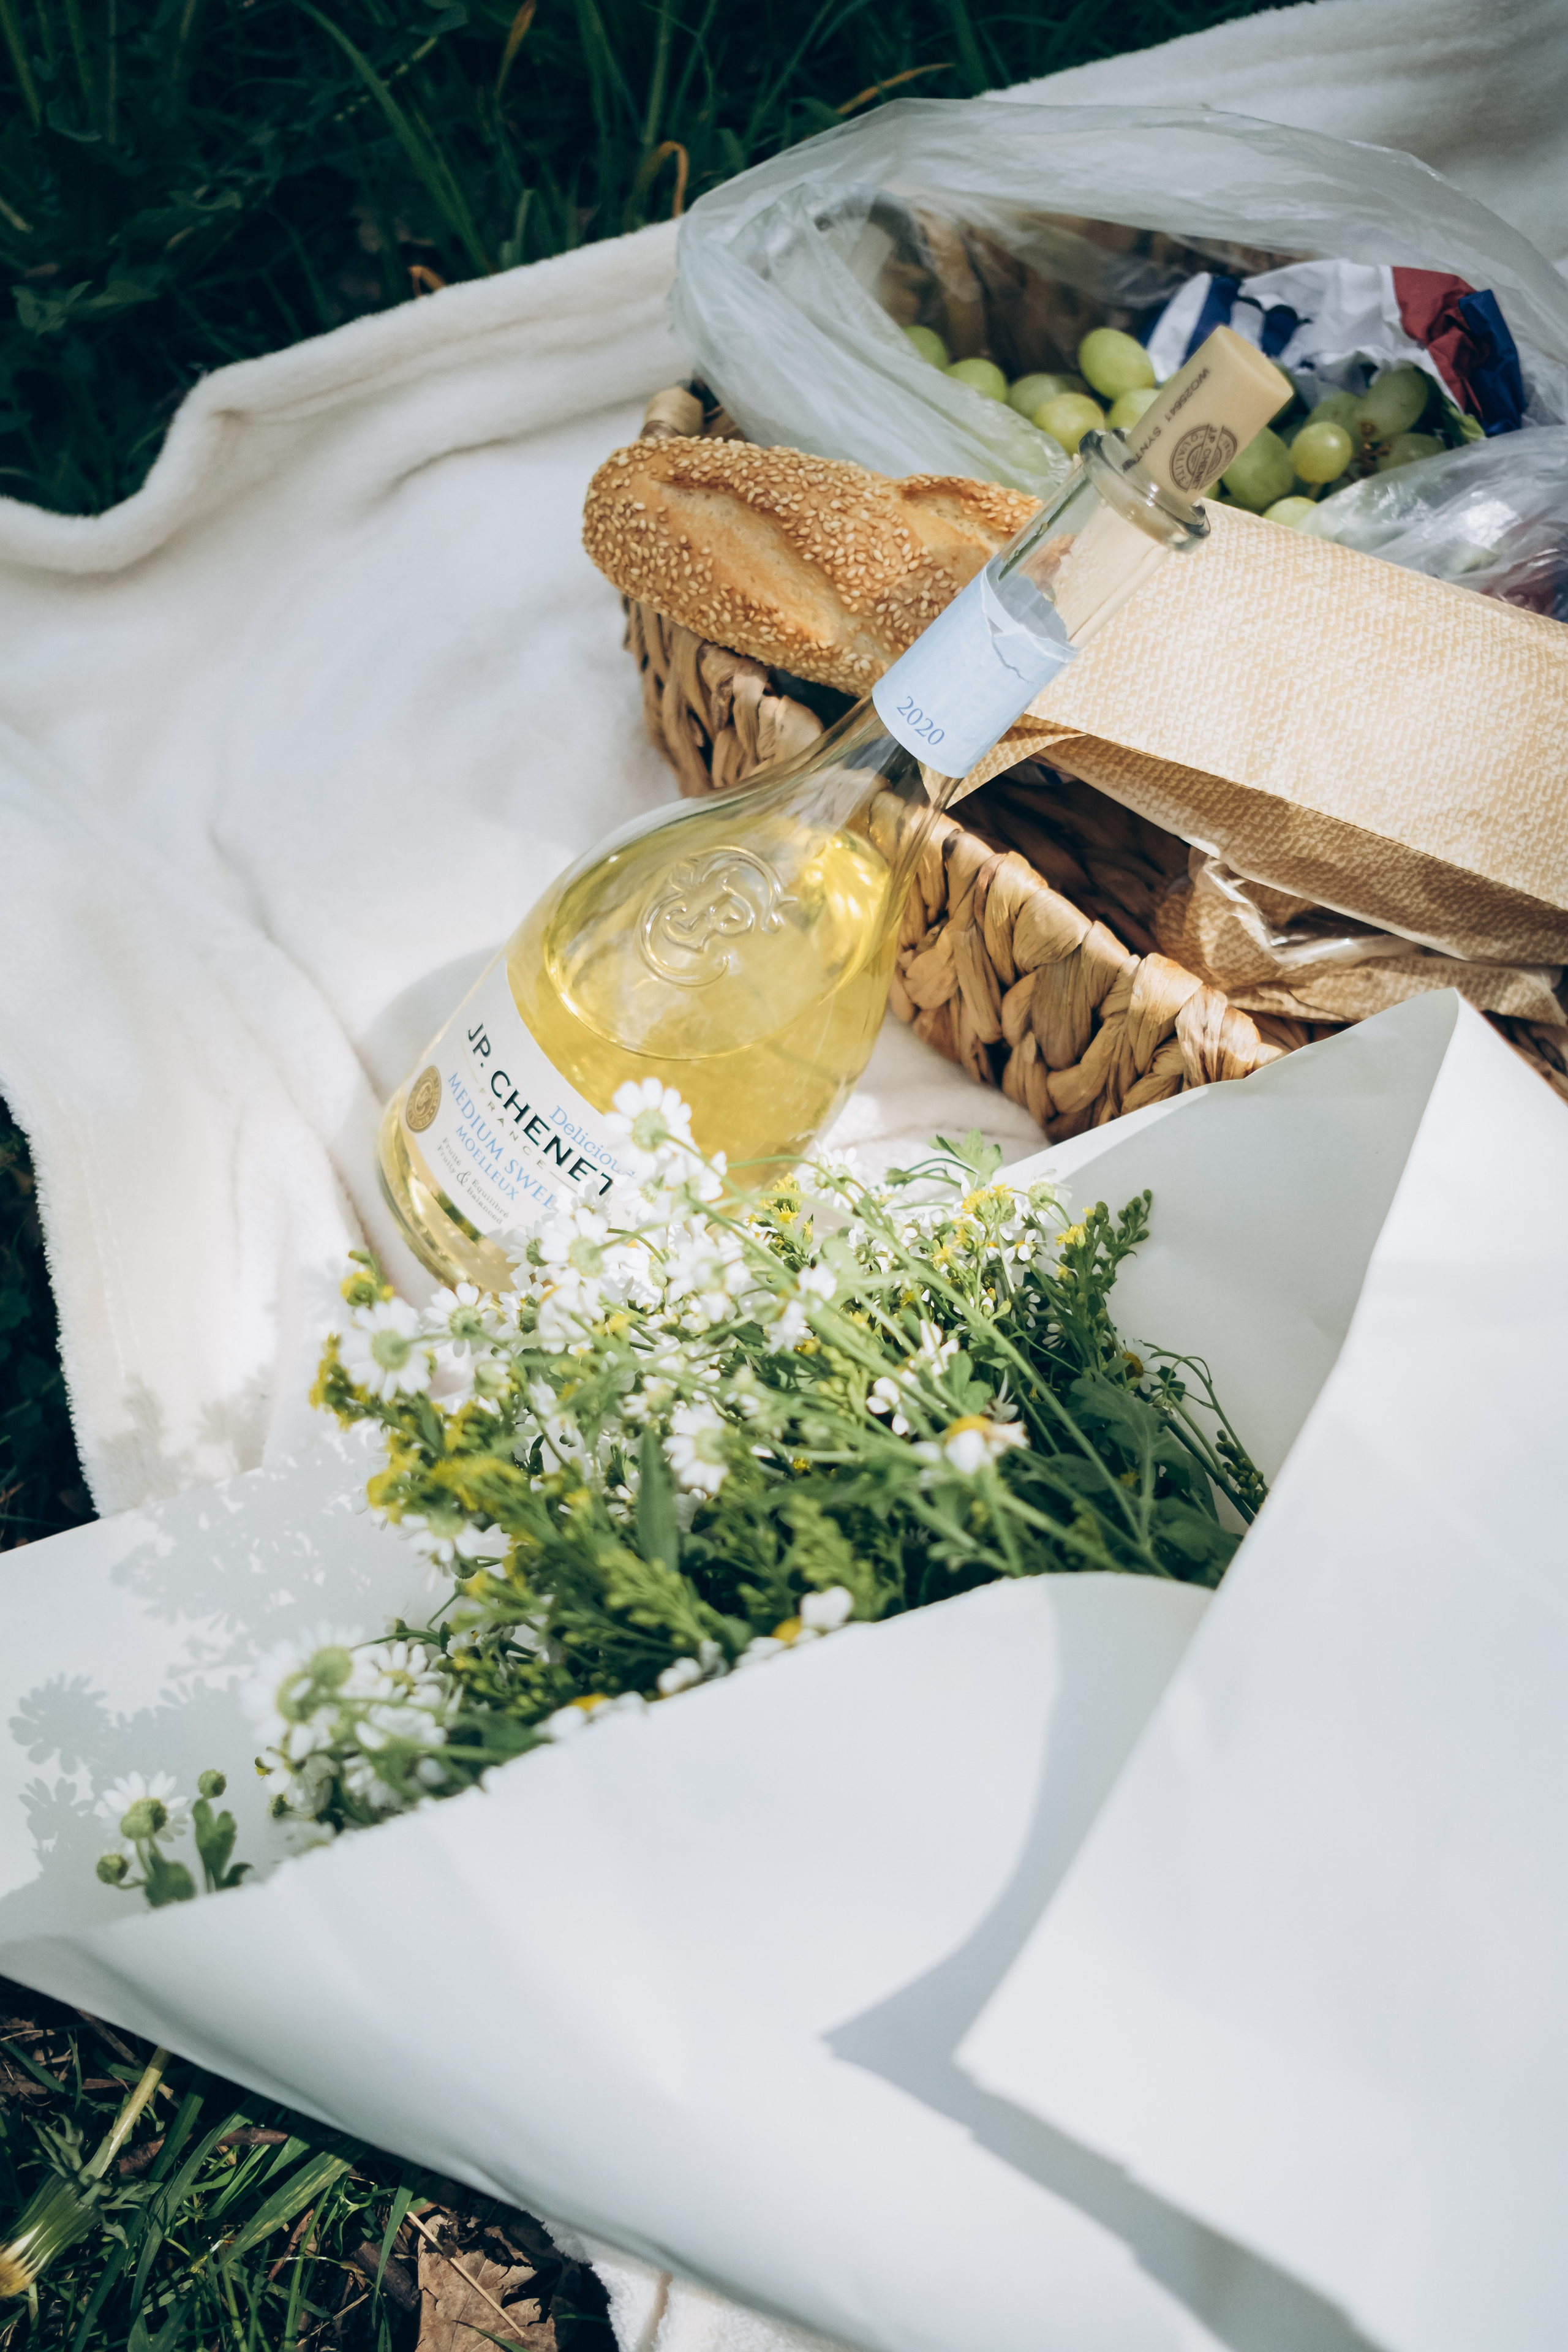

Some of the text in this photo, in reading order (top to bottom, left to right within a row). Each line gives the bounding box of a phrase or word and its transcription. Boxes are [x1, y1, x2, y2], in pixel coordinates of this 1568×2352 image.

[1134, 426, 1161, 464] SYNT
[896, 695, 944, 745] 2020
[448, 1072, 505, 1161] MEDIUM
[479, 1087, 546, 1169] FRANCE
[491, 1070, 613, 1196] CHENET
[437, 1145, 456, 1174] Fruity
[456, 1125, 519, 1200] MOELLEUX
[467, 1187, 503, 1224] Balanced
